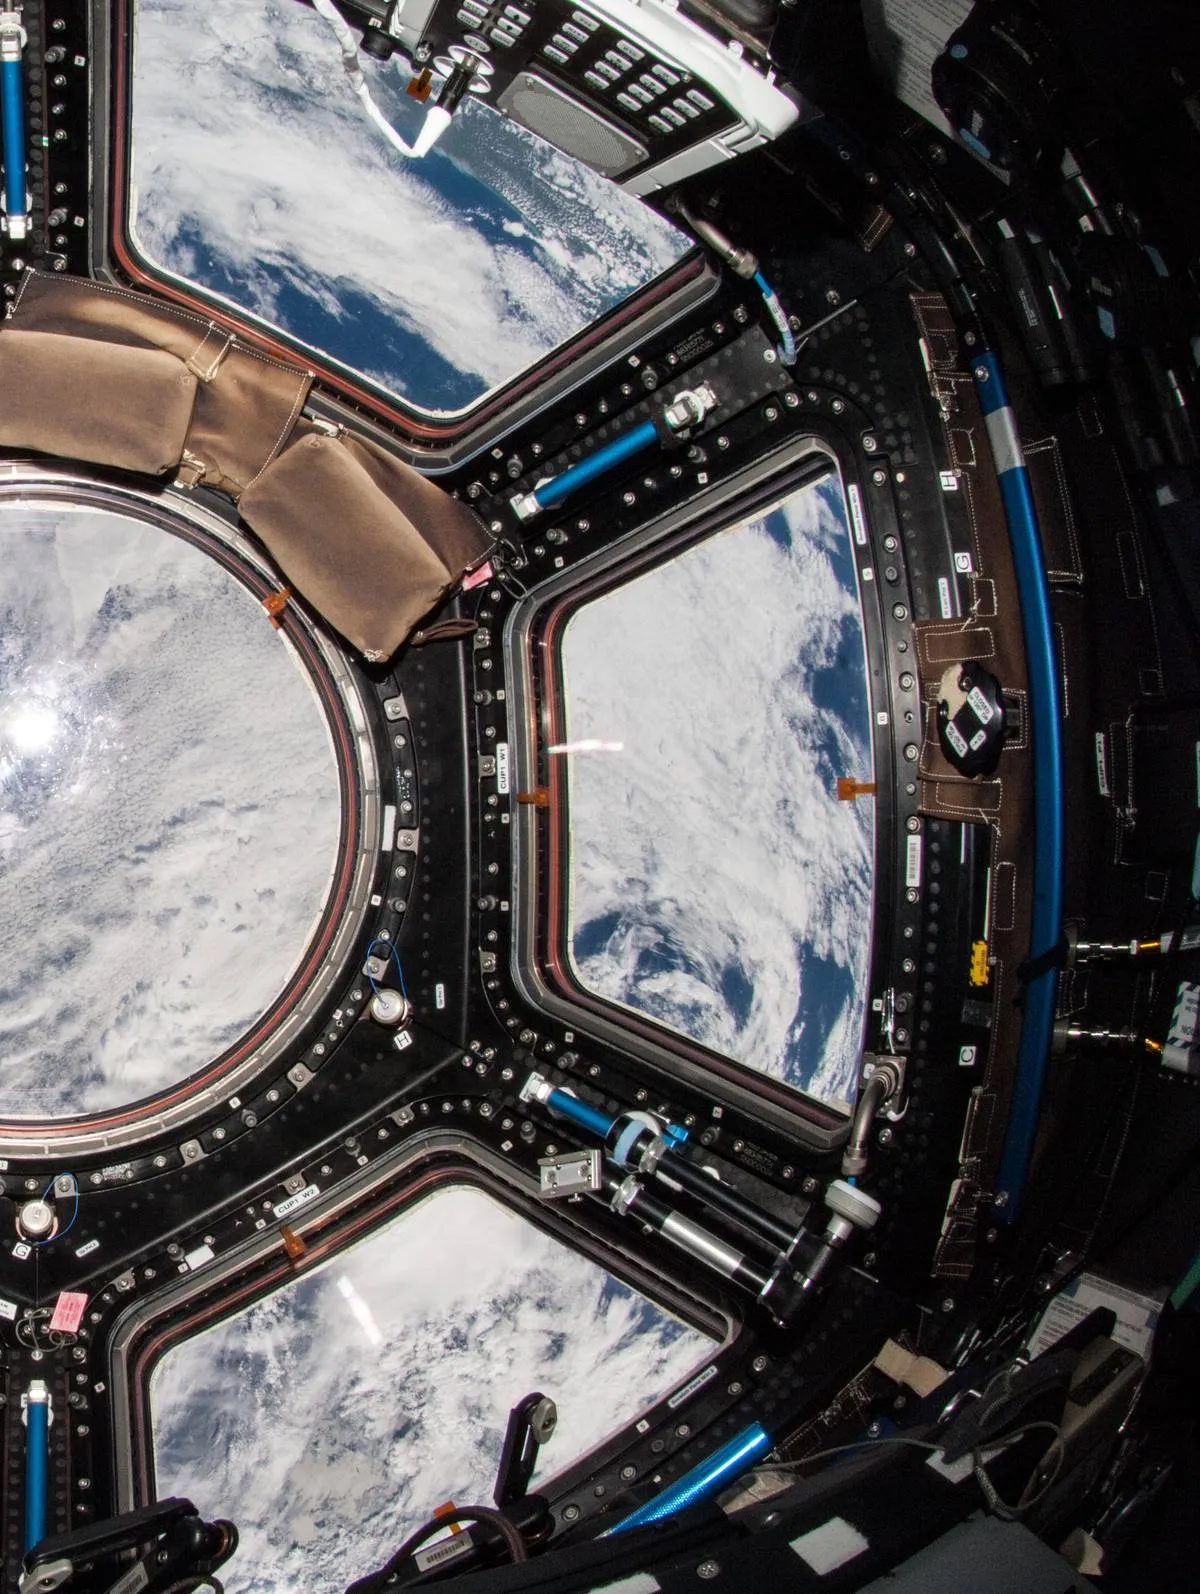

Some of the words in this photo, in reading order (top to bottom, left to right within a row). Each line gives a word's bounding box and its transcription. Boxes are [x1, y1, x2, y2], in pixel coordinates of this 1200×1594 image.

[941, 473, 957, 488] H
[956, 555, 970, 570] G
[499, 748, 506, 761] W1
[499, 766, 507, 789] CUP1
[396, 1033, 408, 1048] H
[961, 1049, 974, 1063] C
[278, 1197, 299, 1214] CUP1
[302, 1188, 316, 1199] W2
[15, 1245, 28, 1257] G
